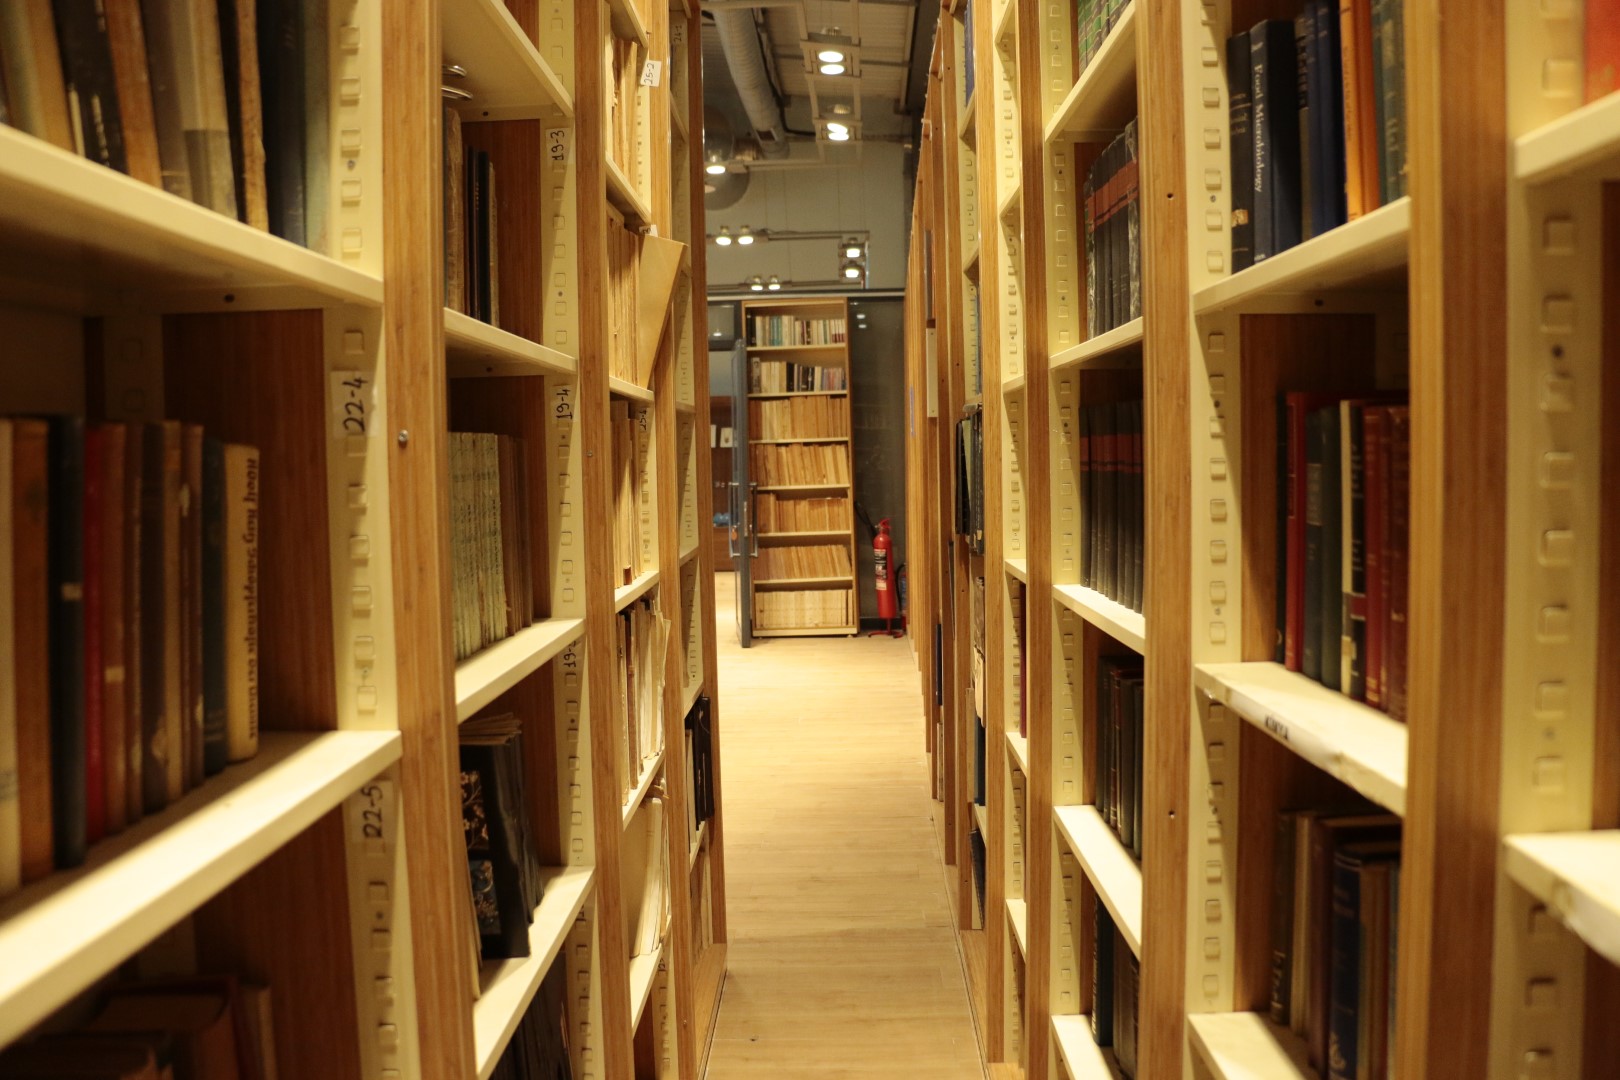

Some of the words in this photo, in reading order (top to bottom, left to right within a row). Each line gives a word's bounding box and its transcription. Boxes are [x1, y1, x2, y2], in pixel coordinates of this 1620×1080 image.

[1254, 63, 1264, 99] Food
[550, 130, 565, 161] 19-3
[1254, 103, 1265, 193] Microbiology
[342, 377, 368, 432] 22-4
[556, 389, 573, 420] 19-4
[361, 785, 383, 838] 22-5
